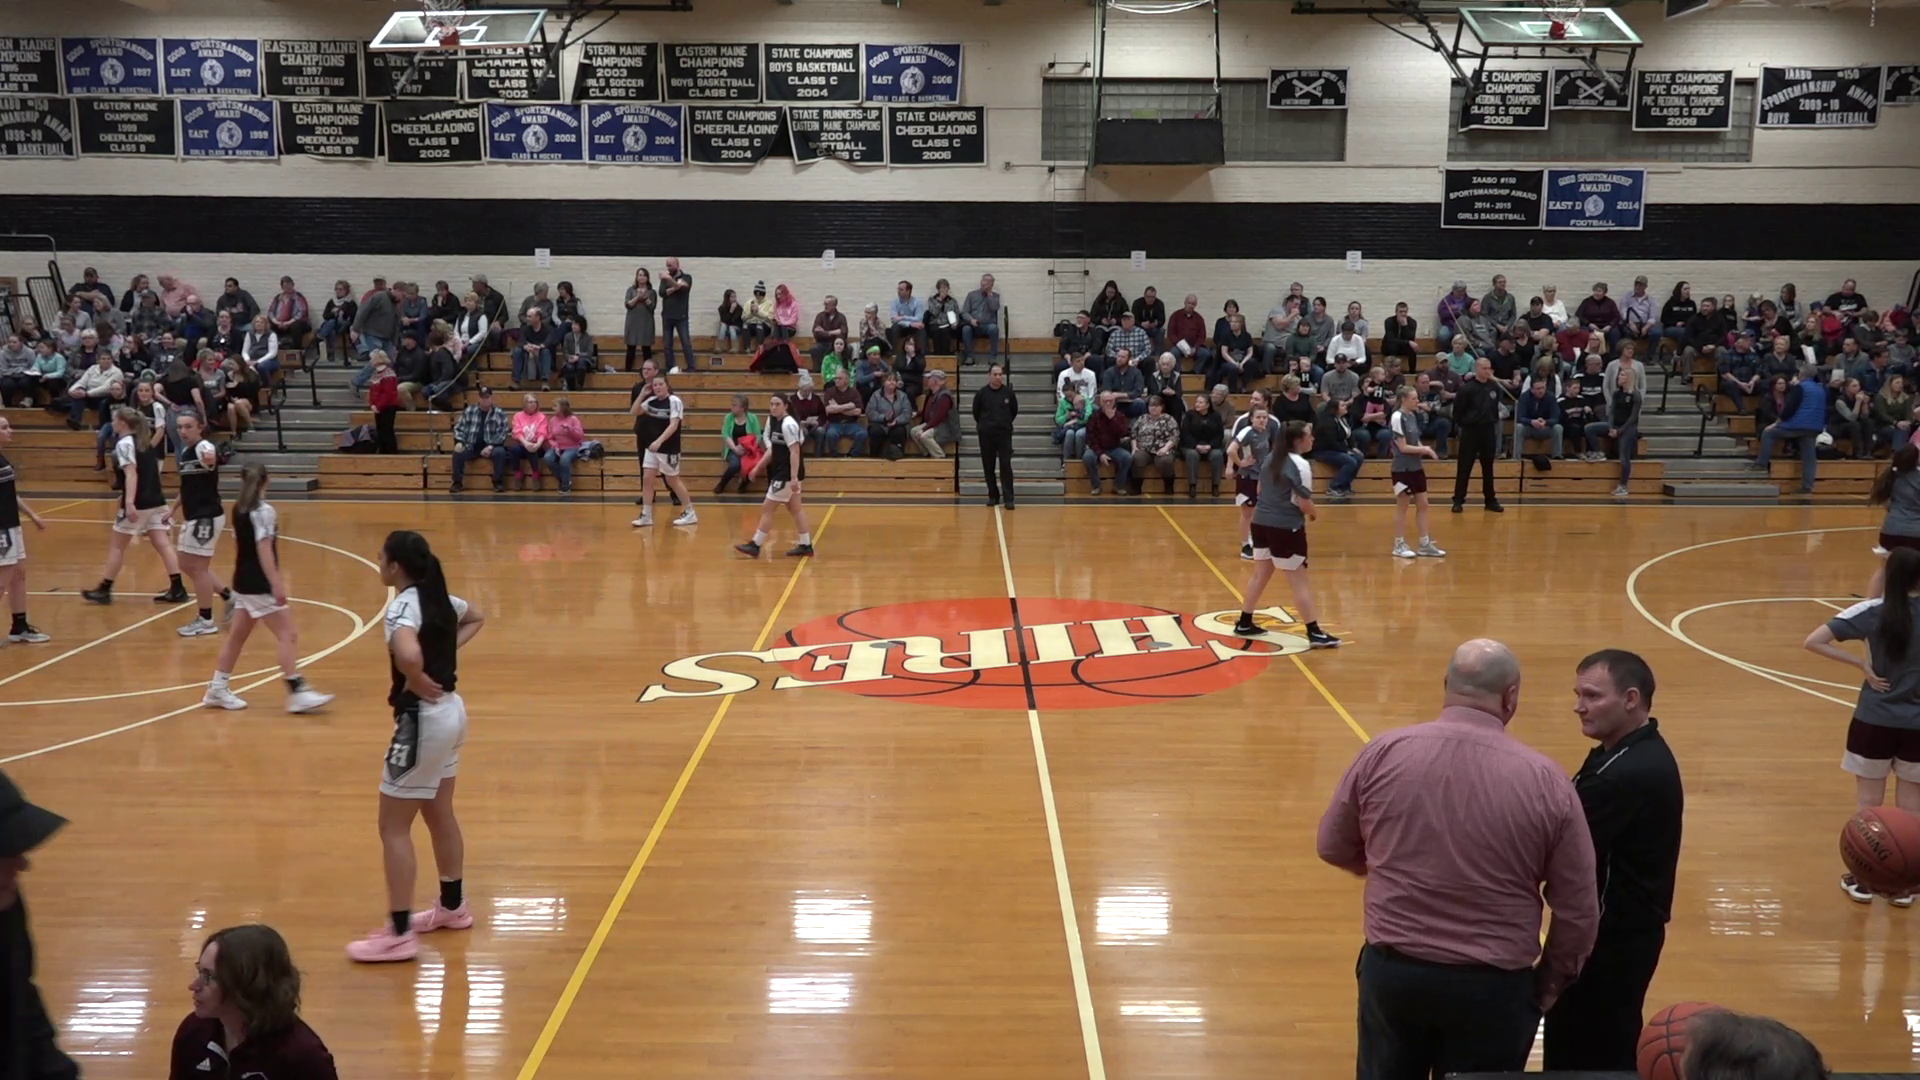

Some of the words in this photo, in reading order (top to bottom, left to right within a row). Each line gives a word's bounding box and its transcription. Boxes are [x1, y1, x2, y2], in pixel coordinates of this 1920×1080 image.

[20, 39, 55, 50] MAINE
[264, 42, 319, 53] EASTERN
[320, 42, 356, 53] MAINE
[90, 39, 154, 62] SPORTSMANSHIP
[97, 47, 123, 57] AWARD
[167, 47, 186, 63] GOOD
[190, 40, 254, 63] SPORTSMANSHIP
[198, 49, 224, 58] AWARD
[618, 46, 647, 55] MAINE
[675, 46, 717, 56] EASTERN
[719, 46, 748, 57] MAINE
[771, 48, 800, 58] STATE
[804, 48, 853, 59] CHAMPIONS
[280, 54, 345, 66] CHAMPIONS
[869, 51, 889, 68] GOOD
[892, 46, 956, 68] SPORTSMANSHIP
[899, 55, 927, 64] AWARD
[680, 58, 744, 68] CHAMPIONS
[769, 62, 793, 73] BOYS
[796, 62, 856, 73] BASKETBALL
[71, 68, 91, 76] EAST
[170, 68, 191, 77] EAST
[472, 69, 496, 77] GIRLS
[596, 68, 627, 77] 2003
[696, 68, 728, 77] 2004
[1492, 72, 1542, 82] CHAMPIONS
[10, 74, 38, 82] SOCCER
[282, 77, 344, 86] CHEERLEADING
[609, 79, 644, 87] SOCCER
[670, 78, 695, 87] BOYS
[697, 78, 755, 88] BASKETBALL
[788, 76, 826, 85] CLASS
[830, 76, 838, 85] C
[872, 76, 893, 85] EAST
[1644, 73, 1671, 83] STATE
[1675, 73, 1725, 84] CHAMPIONS
[489, 79, 527, 88] CLASS
[1486, 83, 1535, 93] CHAMPIONS
[295, 86, 321, 96] CLASS
[498, 90, 529, 98] 2002
[589, 88, 625, 97] CLASS
[628, 88, 636, 97] C
[688, 88, 727, 97] CLASS
[730, 88, 738, 98] C
[796, 88, 828, 97] 2004
[1649, 85, 1667, 95] PVC
[1670, 85, 1719, 95] CHAMPIONS
[1761, 80, 1837, 110] SPORTSMANSHIP
[1846, 85, 1877, 110] AWARD
[1506, 95, 1541, 105] CHAMPIONS
[1642, 96, 1655, 106] PVC
[1657, 96, 1687, 106] REGIONAL
[1689, 96, 1725, 106] CHAMPIONS
[93, 102, 131, 111] EASTERN
[134, 102, 158, 111] MAINE
[184, 107, 204, 123] GOOD
[207, 100, 270, 122] SPORTSMANSHIP
[292, 103, 334, 113] EASTERN
[336, 104, 364, 114] MAINE
[1470, 106, 1496, 114] CLASS
[1509, 107, 1532, 115] GOLF
[214, 109, 240, 118] AWARD
[491, 111, 510, 128] GOOD
[515, 106, 579, 128] SPORTSMANSHIP
[592, 111, 612, 128] GOOD
[614, 106, 678, 128] SPORTSMANSHIP
[694, 110, 723, 120] STATE
[726, 111, 777, 121] CHAMPIONS
[793, 109, 819, 119] STATE
[823, 109, 879, 119] RUNNERS-UP
[896, 111, 926, 122] STATE
[929, 111, 976, 122] CHAMPIONS
[1691, 108, 1714, 116] GOLF
[104, 113, 148, 122] CHAMPIONS
[295, 115, 359, 125] CHAMPIONS
[521, 114, 548, 123] AWARD
[622, 114, 649, 124] AWARD
[1767, 112, 1790, 124] BOYS
[1815, 112, 1869, 124] BASKETBALL
[314, 126, 343, 135] 2001
[391, 122, 475, 134] CHEERLEADING
[693, 124, 778, 134] CHEERLEADING
[793, 121, 820, 131] EASTERN
[823, 122, 843, 131] MAINE
[846, 121, 881, 131] CHAMPIONS
[895, 125, 977, 135] CHEERLEADING
[99, 133, 156, 143] CHEERLEADING
[187, 129, 209, 139] EAST
[494, 133, 516, 142] EAST
[554, 134, 576, 143] 2002
[594, 135, 616, 143] EAST
[820, 132, 852, 141] 2004
[296, 135, 359, 145] CHEERLEADING
[408, 137, 446, 146] CLASS
[451, 137, 459, 145] B
[654, 135, 675, 145] 2004
[710, 138, 751, 147] CLASS
[753, 138, 761, 147] C
[911, 138, 949, 148] CLASS
[952, 138, 961, 148] C
[17, 143, 65, 156] BASKETBALL
[109, 144, 137, 153] CLASS
[304, 145, 343, 155] CLASS
[345, 146, 353, 155] B
[419, 149, 450, 158] 2002
[512, 152, 530, 160] CLASS
[720, 150, 752, 158] 2004
[852, 151, 861, 160] C
[1577, 173, 1632, 187] SPORTSMANSHIP
[1578, 183, 1611, 192] AWARD
[1449, 188, 1510, 200] SPORTSMANSHIP
[1510, 190, 1537, 201] AWARD
[1548, 201, 1573, 210] EAST
[1574, 201, 1582, 209] D
[1616, 201, 1639, 209] 2014
[1457, 212, 1479, 220] GIRLS
[1480, 212, 1526, 221] BASKETBALL
[198, 526, 211, 538] H
[637, 607, 1310, 703] SHIRES
